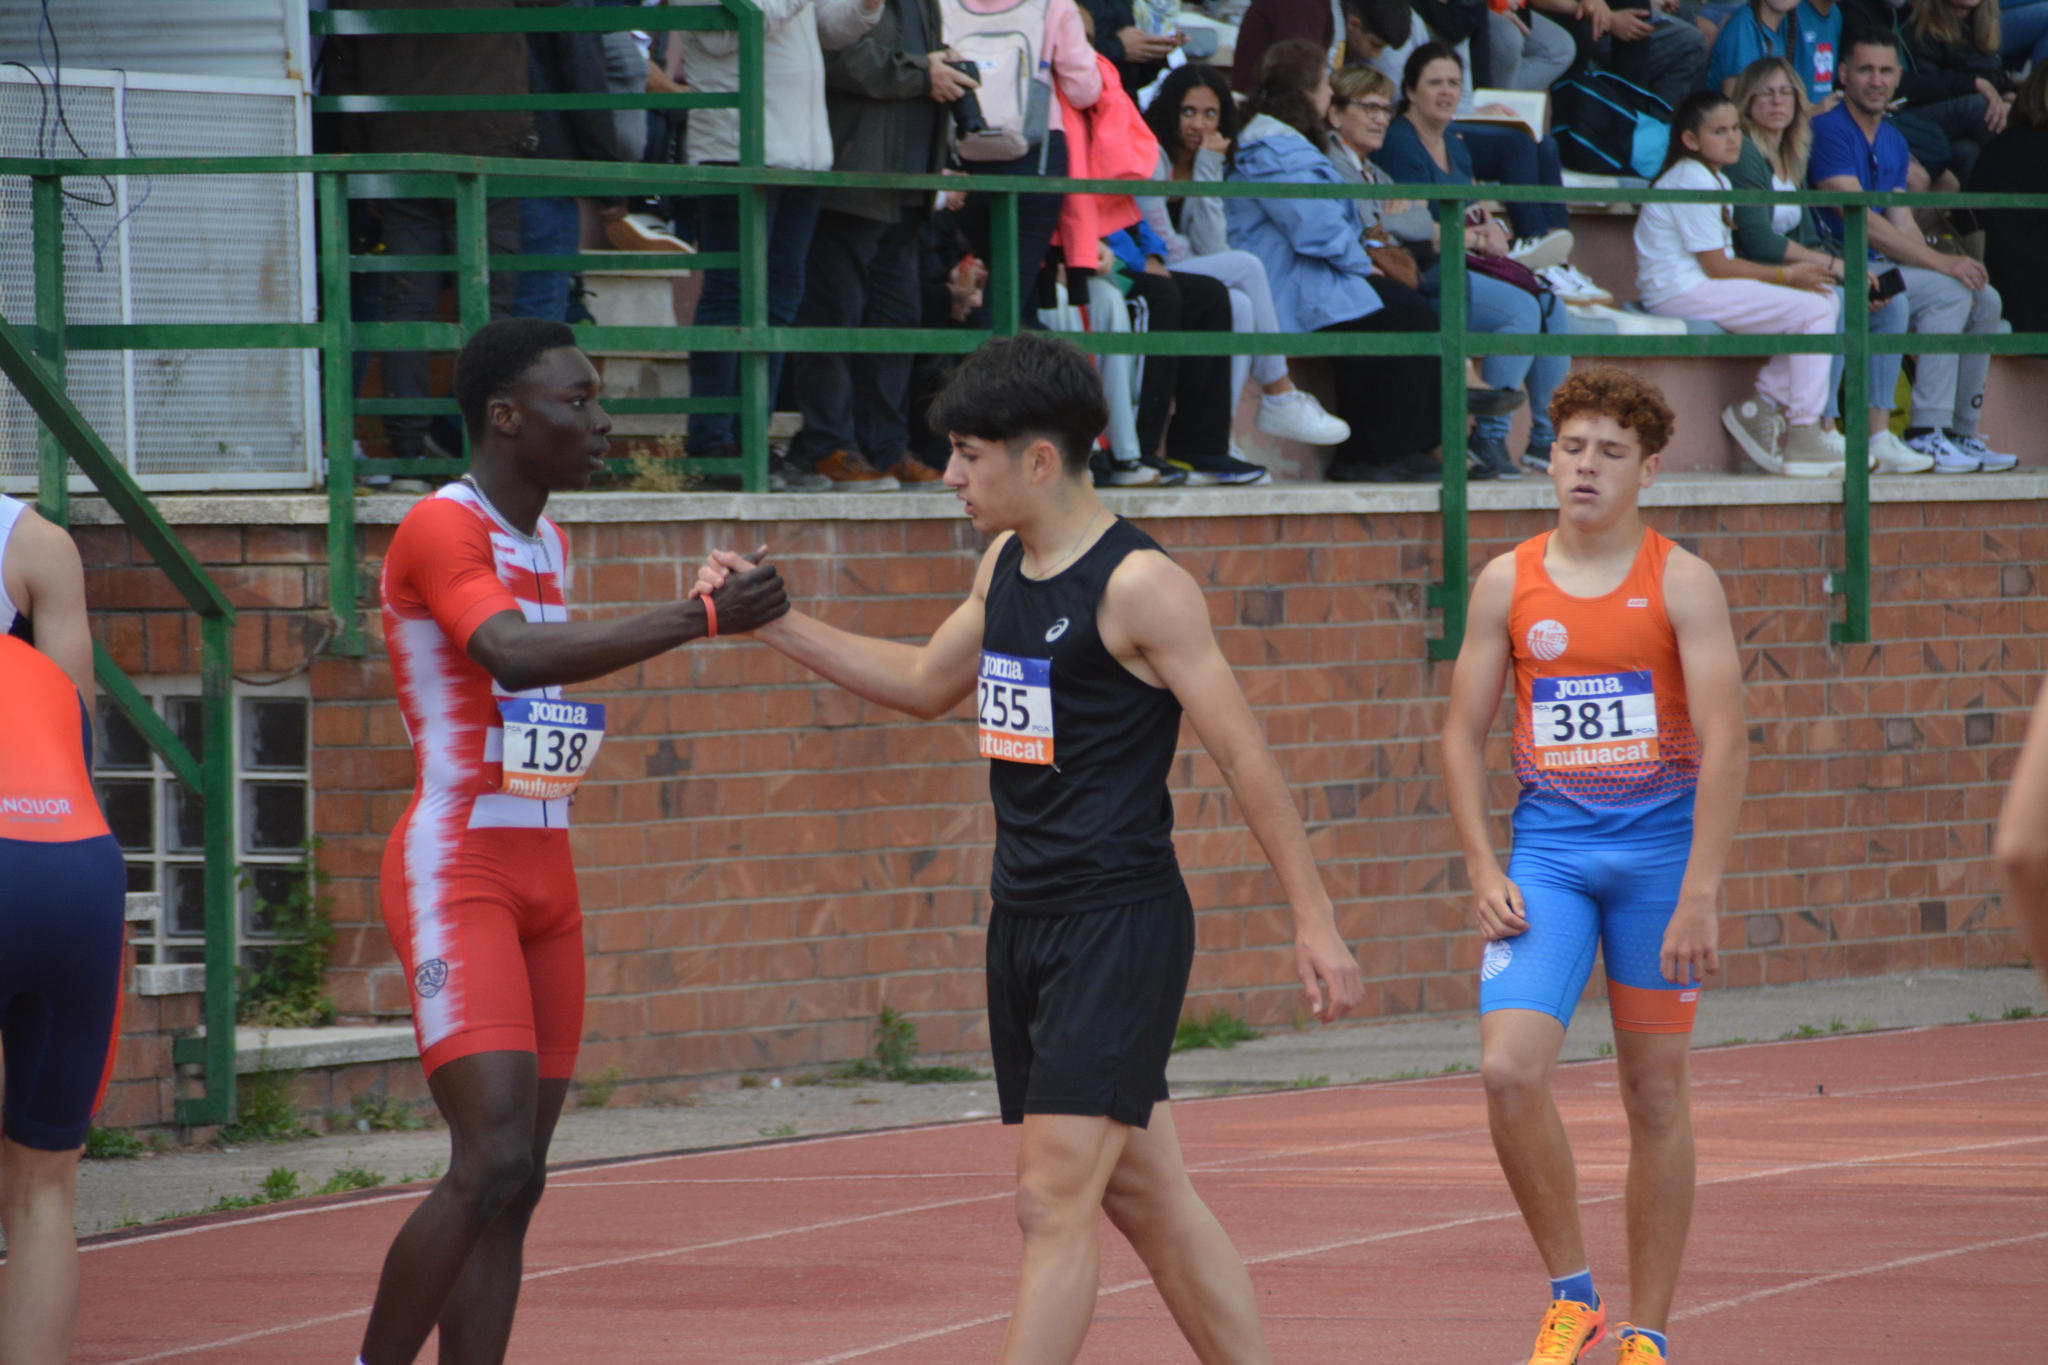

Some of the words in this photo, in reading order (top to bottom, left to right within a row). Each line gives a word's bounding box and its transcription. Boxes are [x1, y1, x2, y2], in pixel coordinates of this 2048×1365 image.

[979, 682, 1030, 731] 255
[1551, 700, 1633, 742] 381
[521, 728, 588, 773] 138
[1544, 741, 1651, 766] mutuacat
